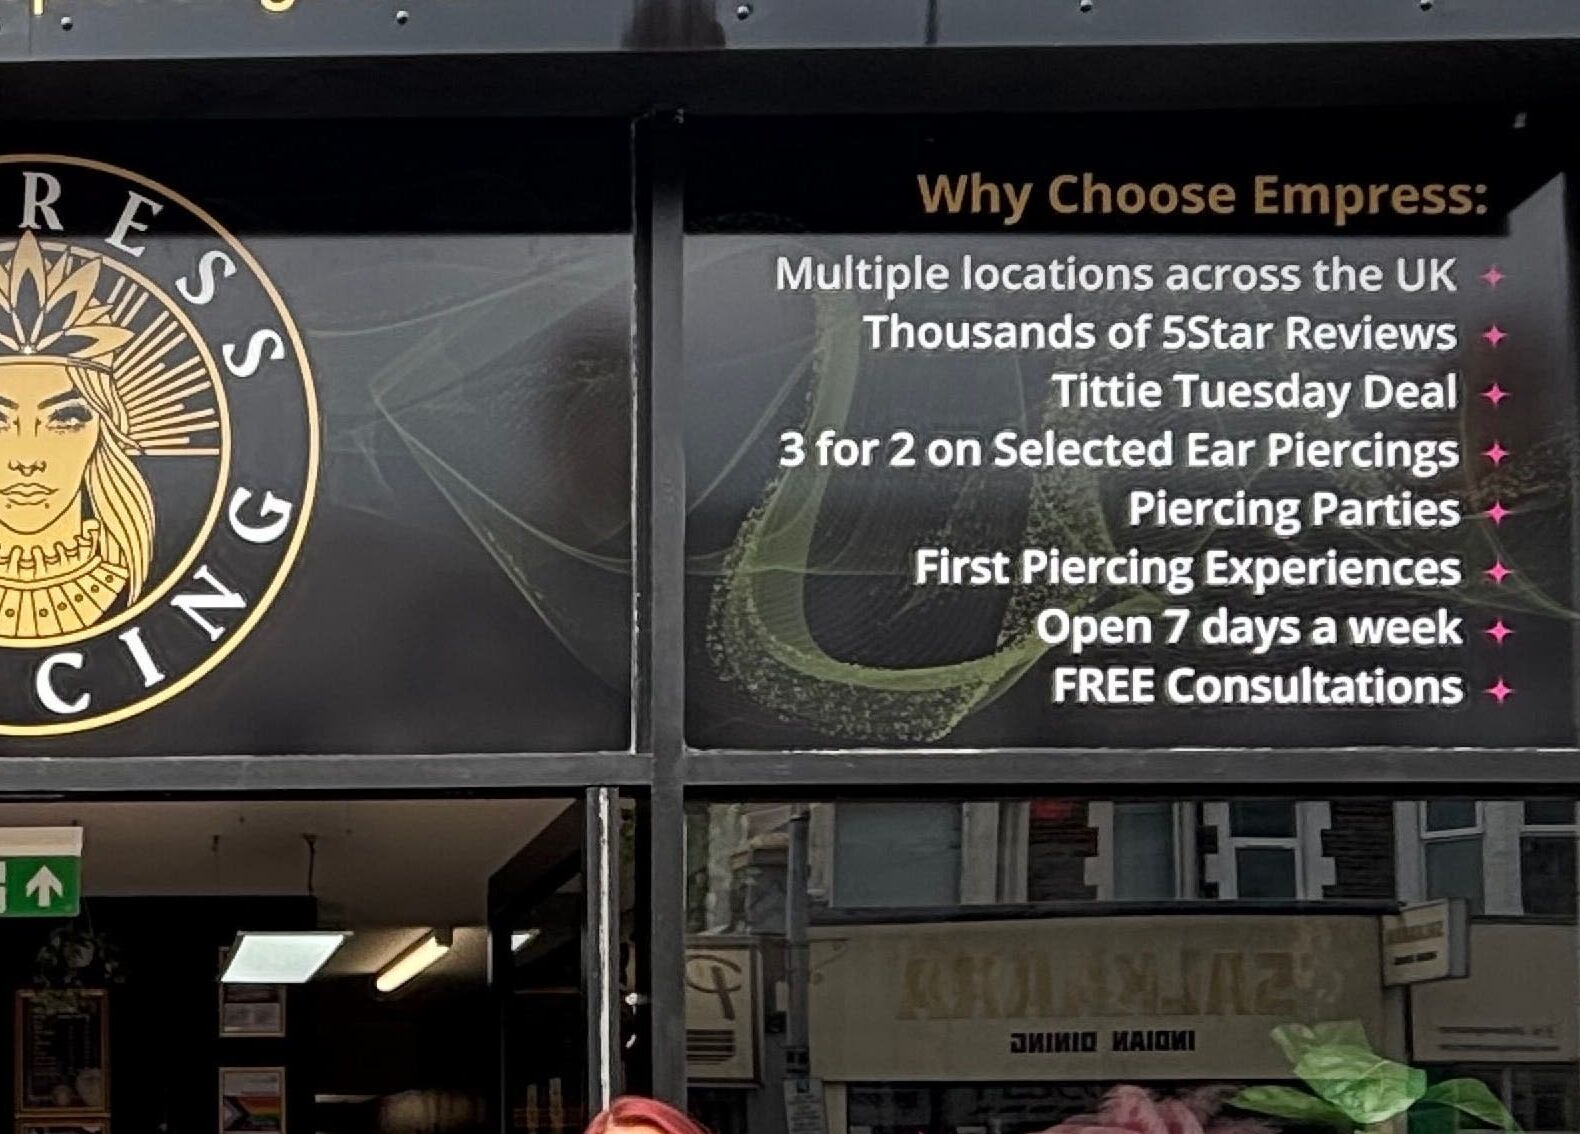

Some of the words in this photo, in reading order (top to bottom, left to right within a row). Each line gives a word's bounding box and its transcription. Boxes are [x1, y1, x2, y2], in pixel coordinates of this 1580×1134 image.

[916, 171, 1034, 226] Why
[1048, 172, 1236, 214] Choose
[1254, 174, 1488, 227] Empress:
[776, 254, 950, 301] Multiple
[963, 254, 1154, 292] locations
[1165, 264, 1302, 292] across
[1312, 255, 1384, 292] the
[1397, 258, 1457, 292] UK
[862, 312, 1096, 350] Thousands
[1107, 312, 1154, 350] of
[1162, 314, 1274, 350] 5Star
[1286, 314, 1458, 351] Reviews
[1051, 372, 1162, 408] Tittie
[1172, 372, 1352, 419] Tuesday
[1364, 372, 1456, 410] Deal
[779, 431, 806, 468] 3
[815, 429, 880, 467] for
[889, 431, 916, 467] 2
[925, 438, 982, 467] on
[994, 429, 1173, 468] Selected
[1187, 432, 1256, 468] Ear
[1268, 431, 1460, 478] Piercings
[1129, 488, 1302, 536] Piercing
[1312, 490, 1461, 529] Parties
[916, 546, 1010, 585] First
[1021, 547, 1194, 596] Piercing
[1205, 549, 1462, 596] Experiences
[1036, 608, 1152, 654] Open
[1162, 608, 1191, 644] 7
[1201, 606, 1301, 655] days
[1310, 616, 1338, 645] a
[1348, 608, 1464, 646] week
[1054, 667, 1155, 704] FREE
[1165, 666, 1464, 705] Consultations
